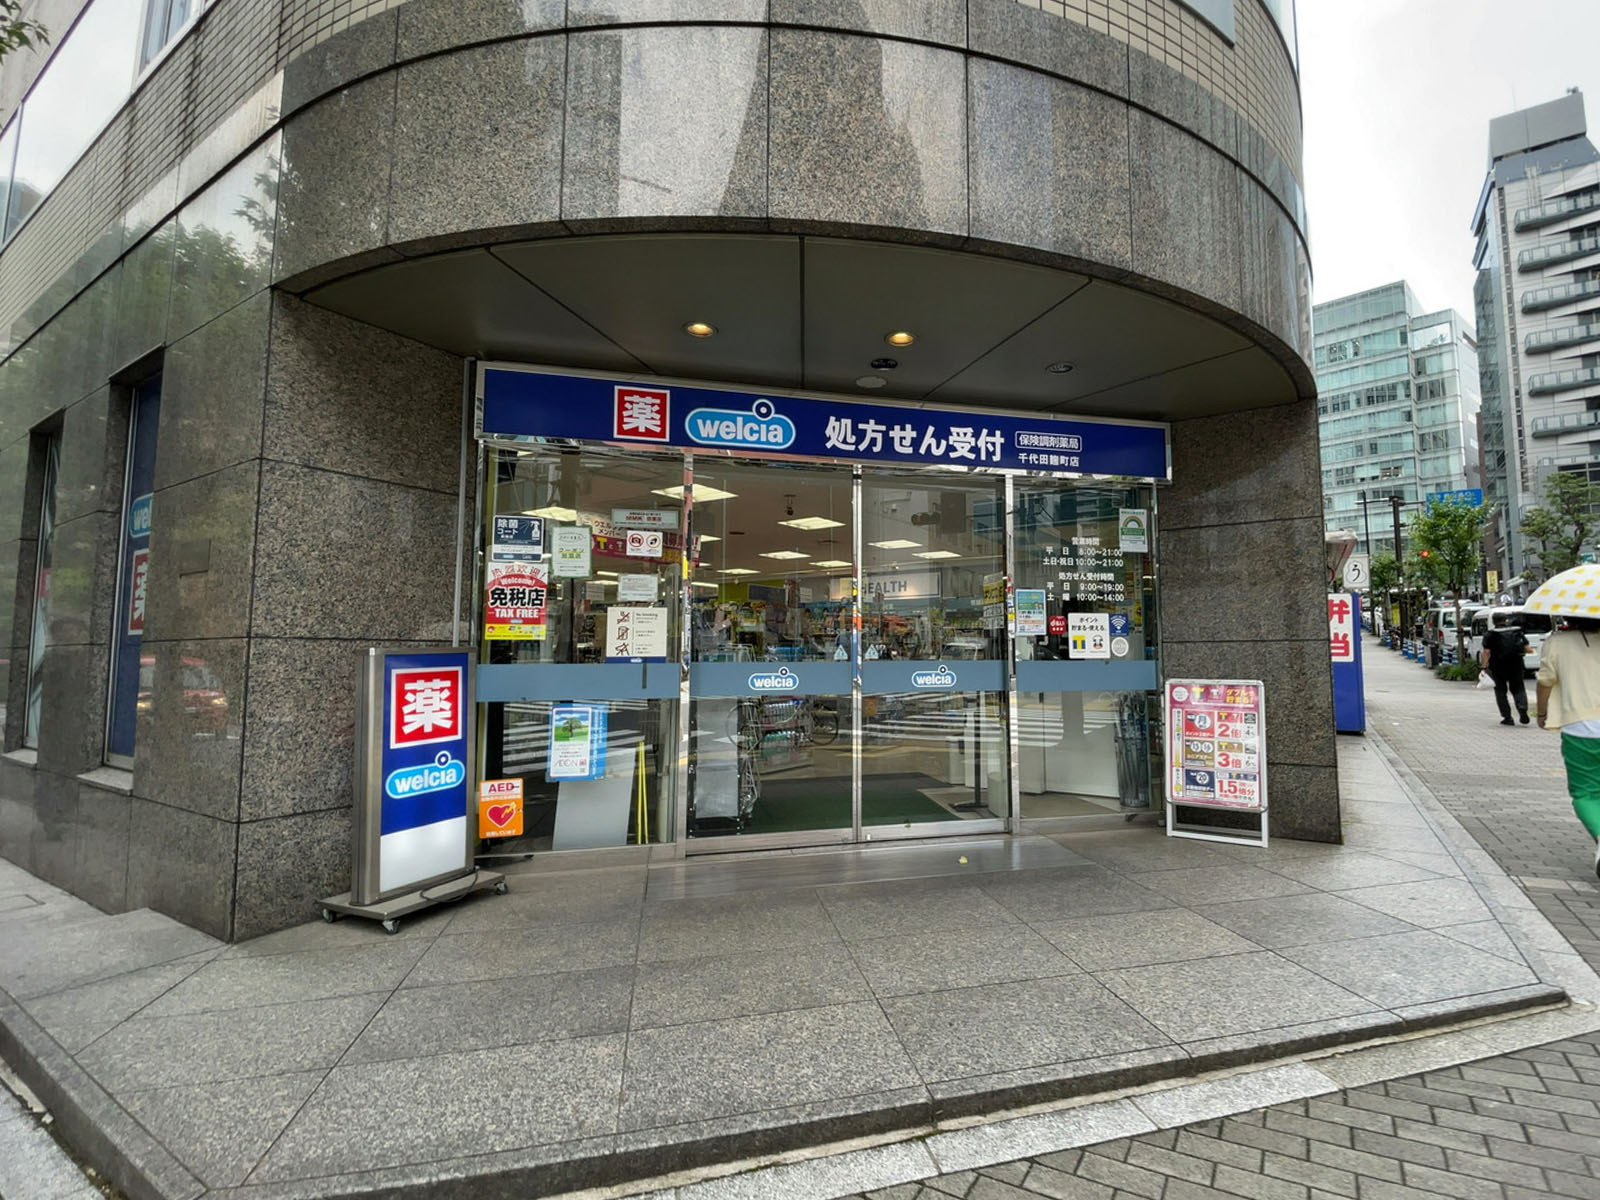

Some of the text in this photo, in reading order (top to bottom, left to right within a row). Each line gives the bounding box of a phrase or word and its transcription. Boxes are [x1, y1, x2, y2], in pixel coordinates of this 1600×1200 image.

[622, 395, 662, 433] 薬
[697, 405, 784, 444] welcia
[825, 416, 1005, 462] 処方せん受付
[1019, 434, 1079, 449] 保険調剤薬局
[497, 518, 519, 529] 除菌
[1071, 536, 1100, 546] 営業時間
[1058, 572, 1115, 581] 処方せん受付時間
[489, 587, 545, 607] 免税店
[495, 608, 539, 618] TAX FREE
[753, 674, 794, 688] welcia
[916, 671, 951, 685] welcia
[402, 678, 453, 735] 薬
[394, 757, 457, 794] welcia
[488, 782, 514, 794] AED
